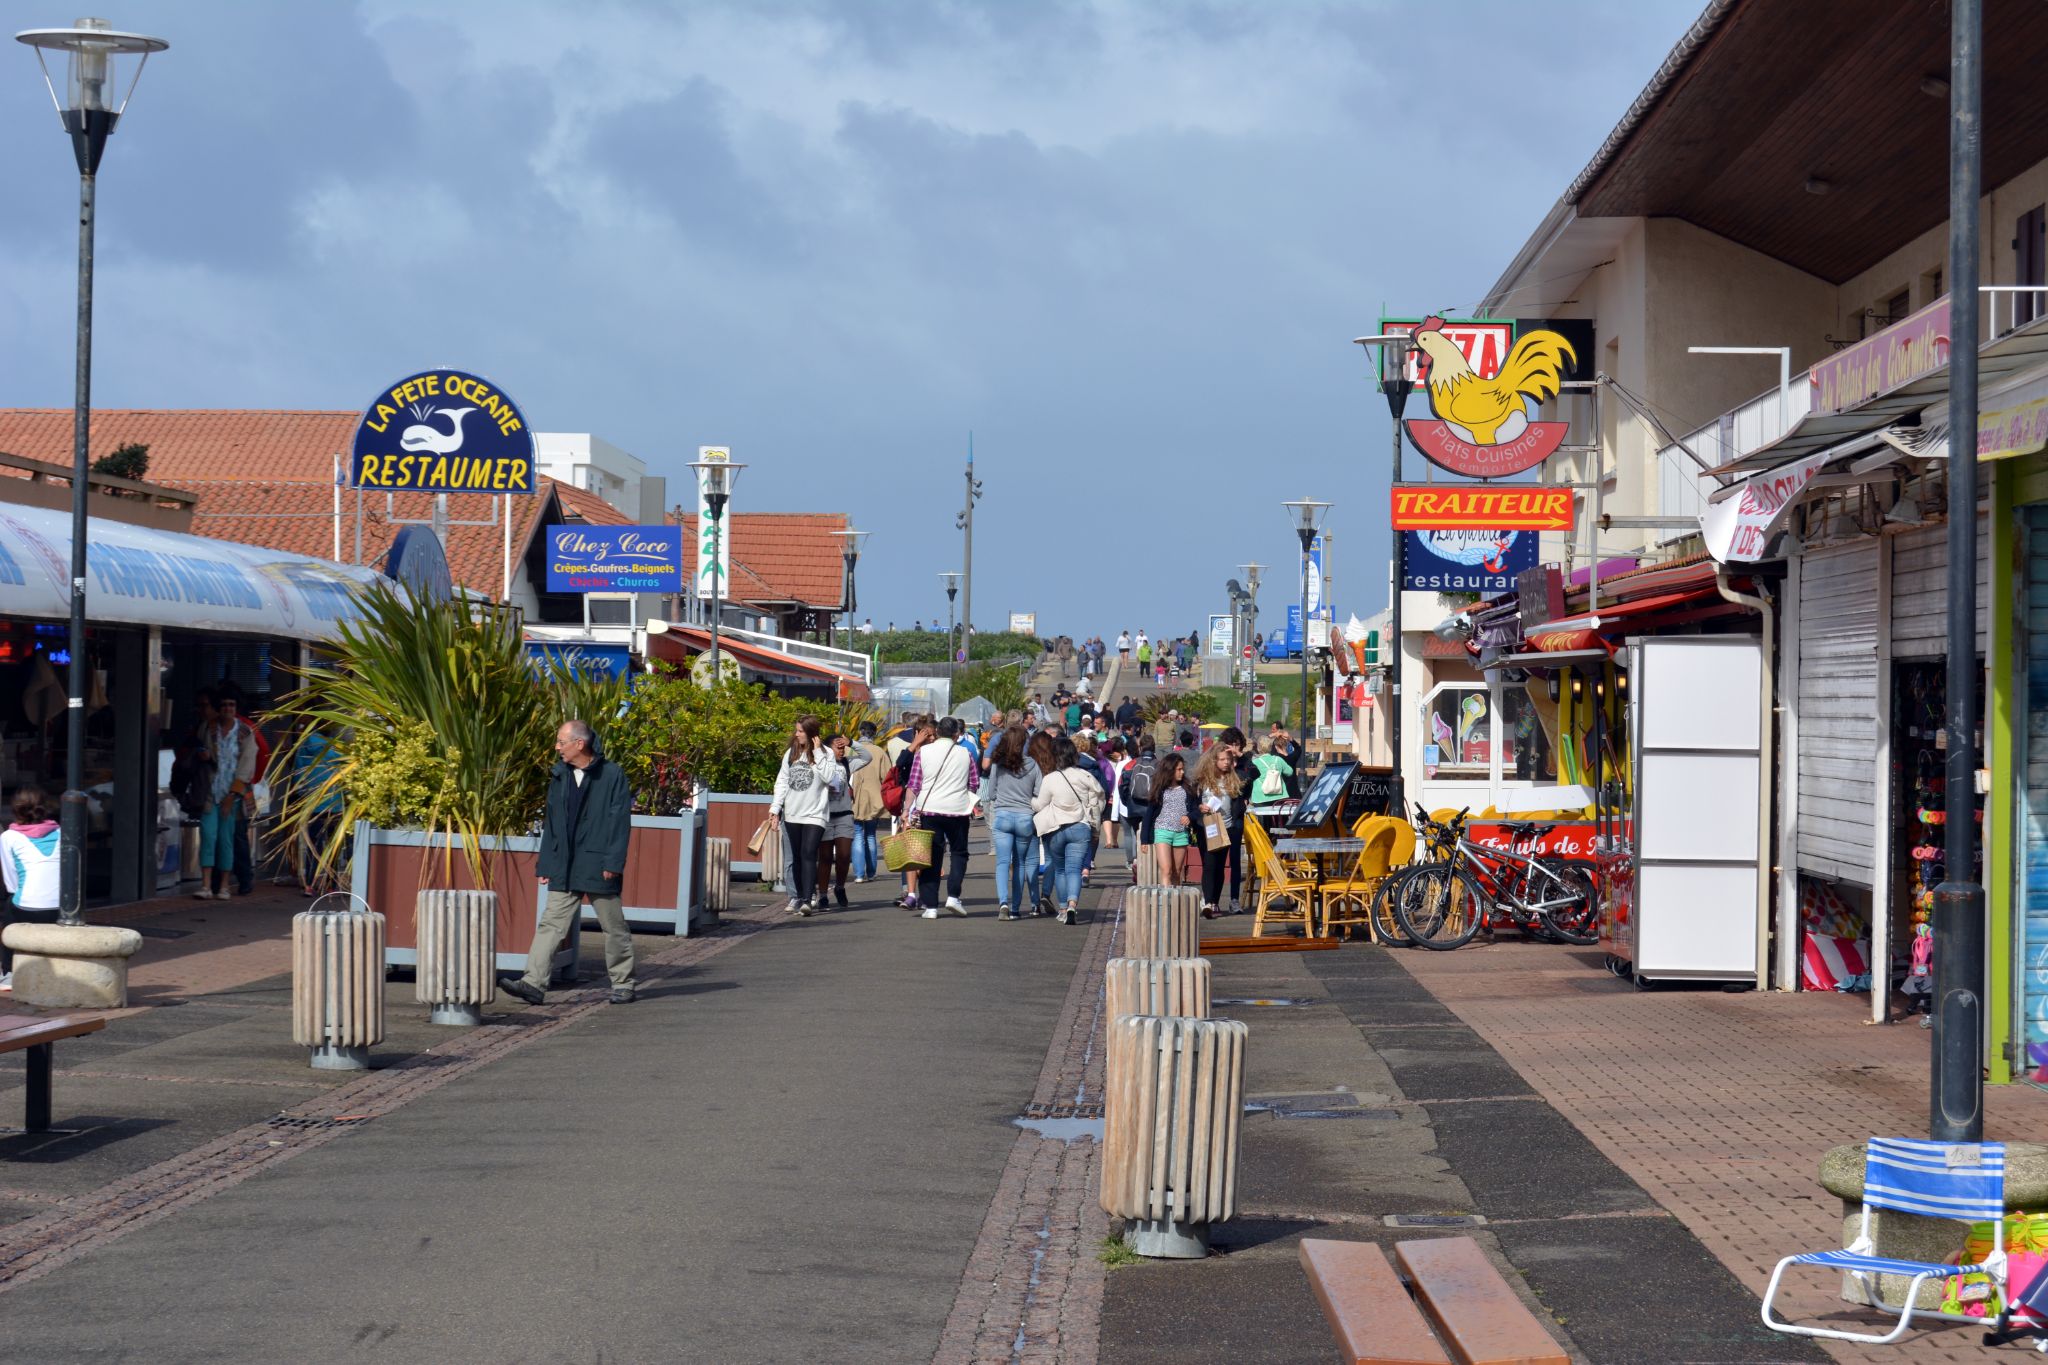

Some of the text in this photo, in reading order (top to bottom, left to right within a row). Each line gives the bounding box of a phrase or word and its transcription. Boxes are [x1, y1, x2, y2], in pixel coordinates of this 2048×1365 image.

[366, 375, 521, 437] LA FETE OCEANE
[1431, 425, 1470, 459] Plats
[359, 454, 528, 490] RESTAUMER
[1459, 458, 1528, 474] emporter
[1396, 493, 1568, 514] TRAITEUR
[555, 532, 672, 561] Chez Coco
[617, 577, 660, 587] Churros
[564, 646, 614, 669] Coco
[1352, 782, 1390, 796] TURSAN
[1553, 836, 1581, 855] de
